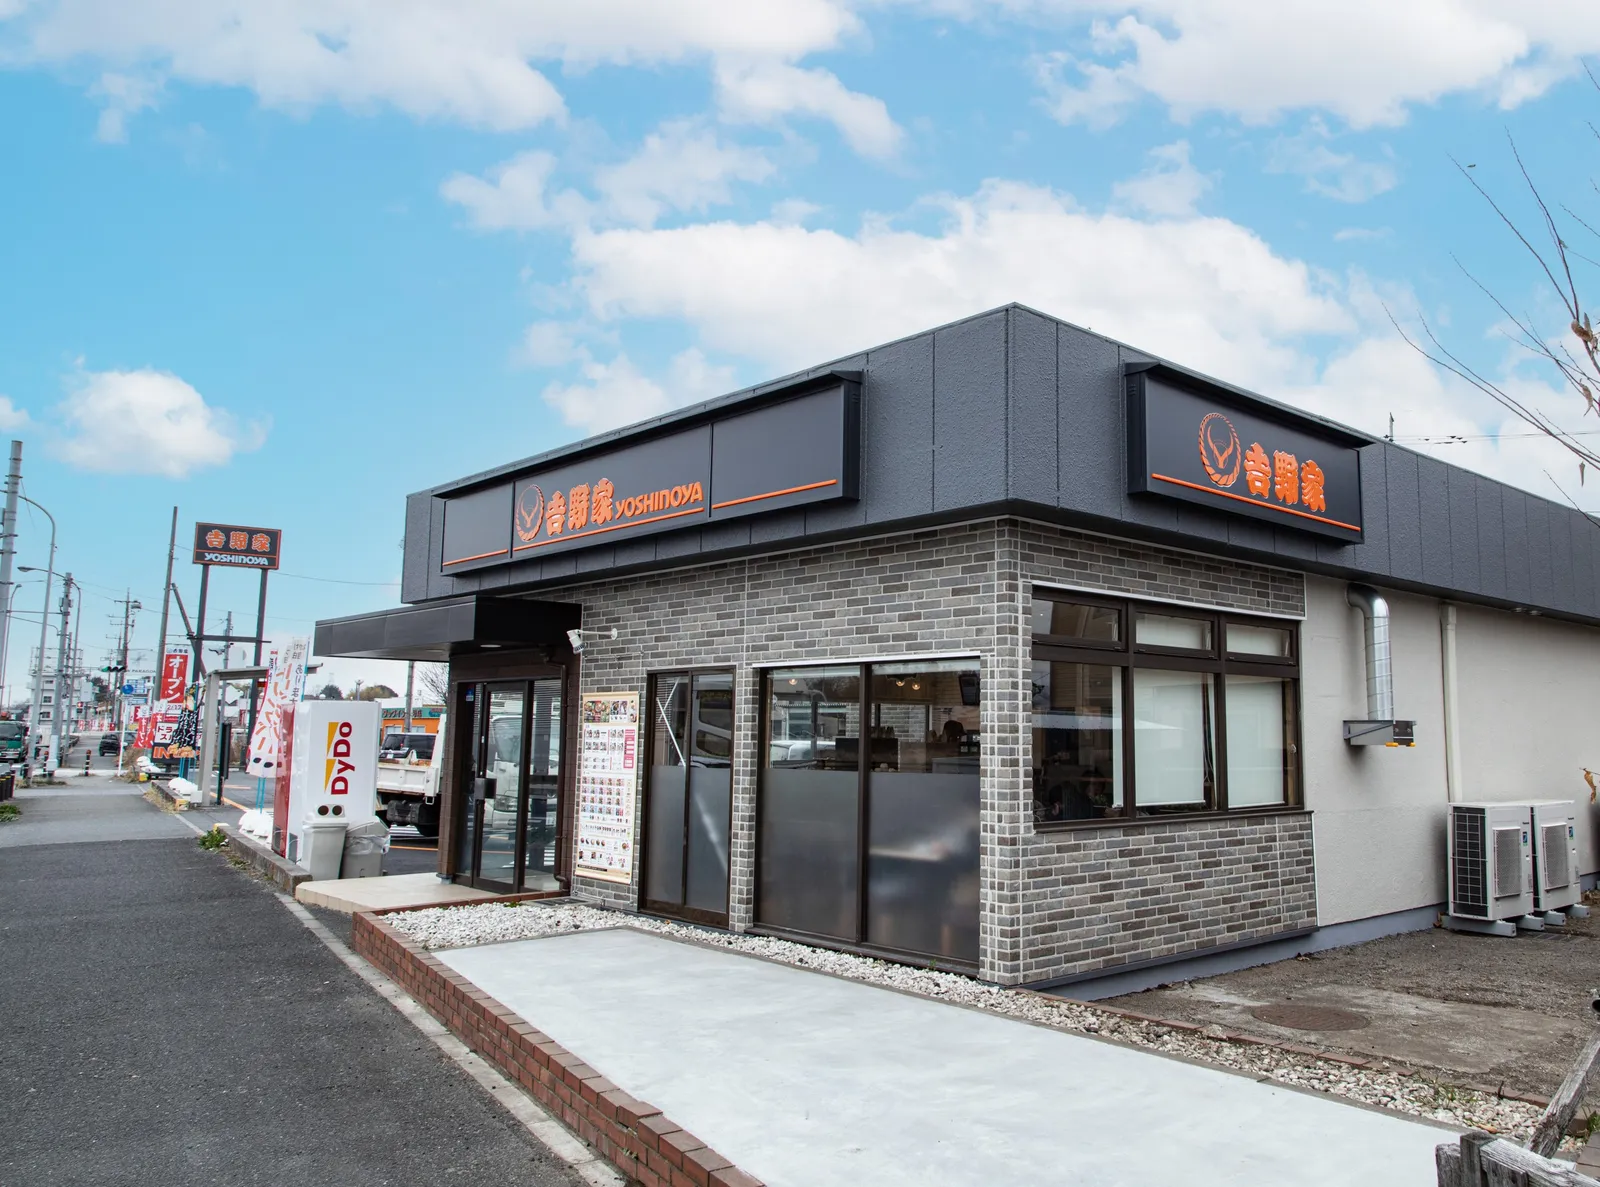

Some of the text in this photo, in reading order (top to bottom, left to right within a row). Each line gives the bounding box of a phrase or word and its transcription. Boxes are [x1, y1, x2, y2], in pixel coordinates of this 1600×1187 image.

[1243, 441, 1327, 513] 吉野家
[545, 477, 615, 536] 吉野家
[615, 481, 704, 520] YOSHINOYA
[204, 553, 268, 565] YOSHINOYA
[205, 529, 270, 552] 吉野家
[167, 655, 184, 704] オープン
[157, 725, 173, 733] ドラ
[331, 722, 355, 795] DyDo
